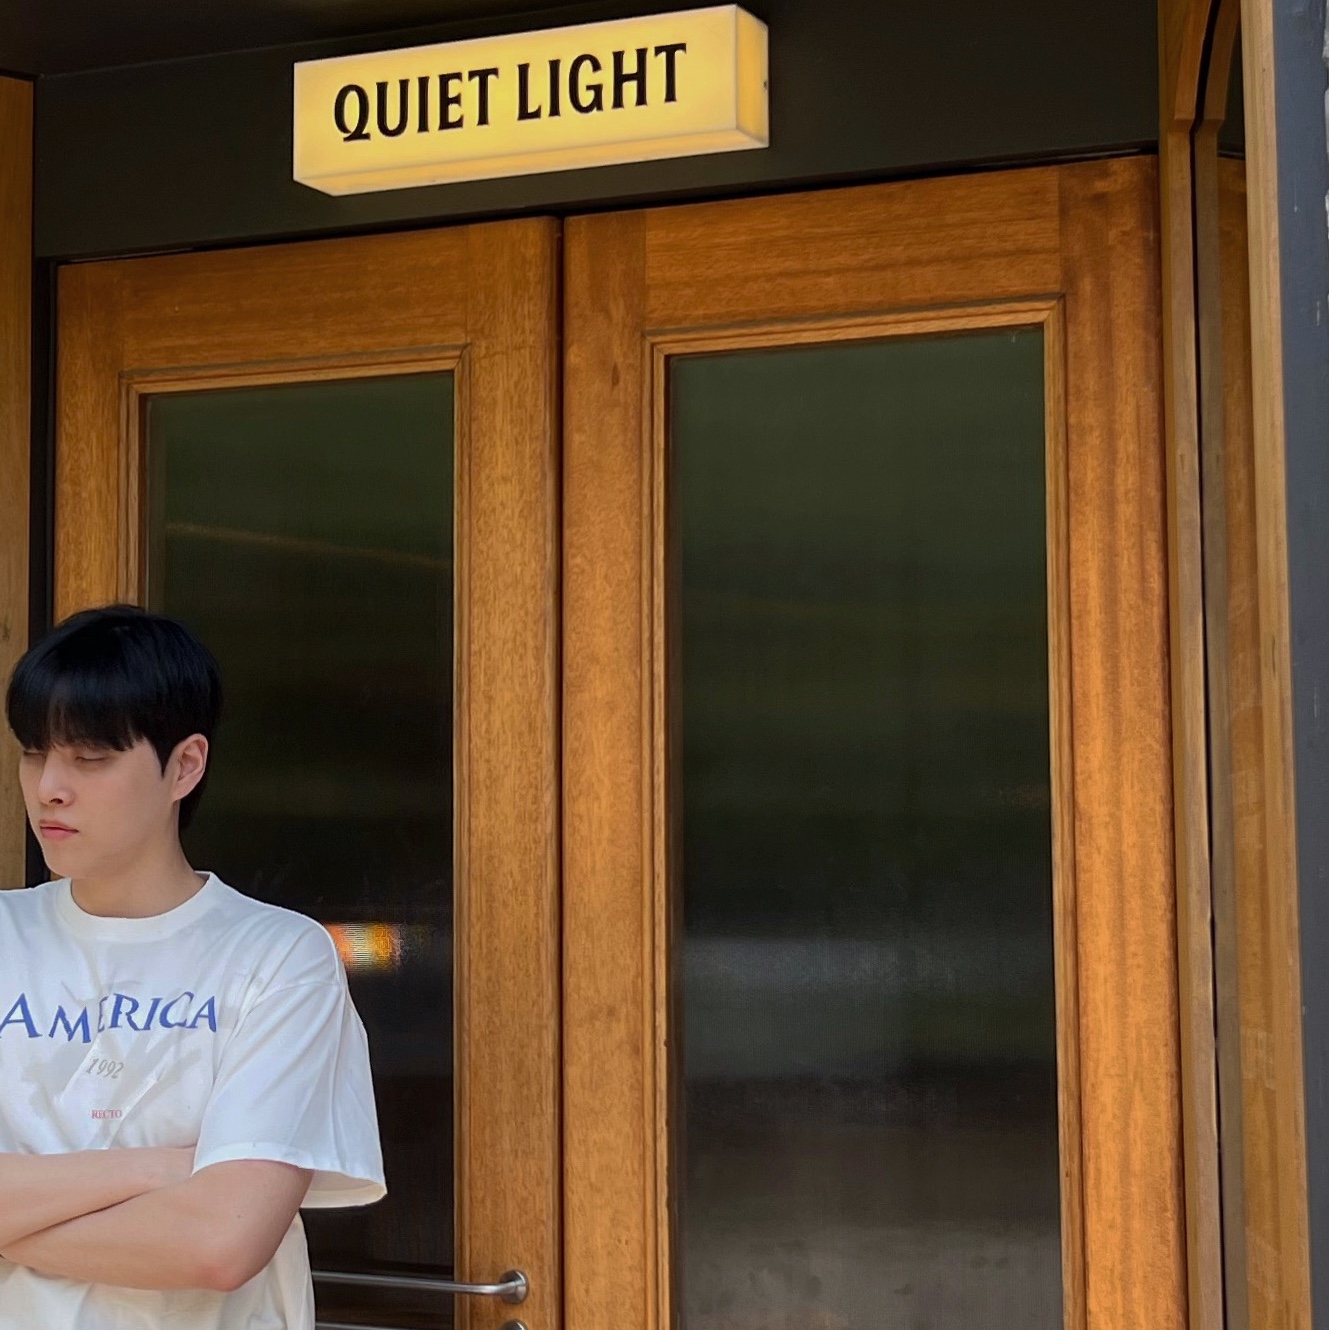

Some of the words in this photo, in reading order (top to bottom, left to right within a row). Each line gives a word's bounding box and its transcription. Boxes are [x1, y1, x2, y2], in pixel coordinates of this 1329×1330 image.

[334, 67, 499, 142] QUIET
[517, 42, 687, 121] LIGHT
[85, 1057, 125, 1080] 1992
